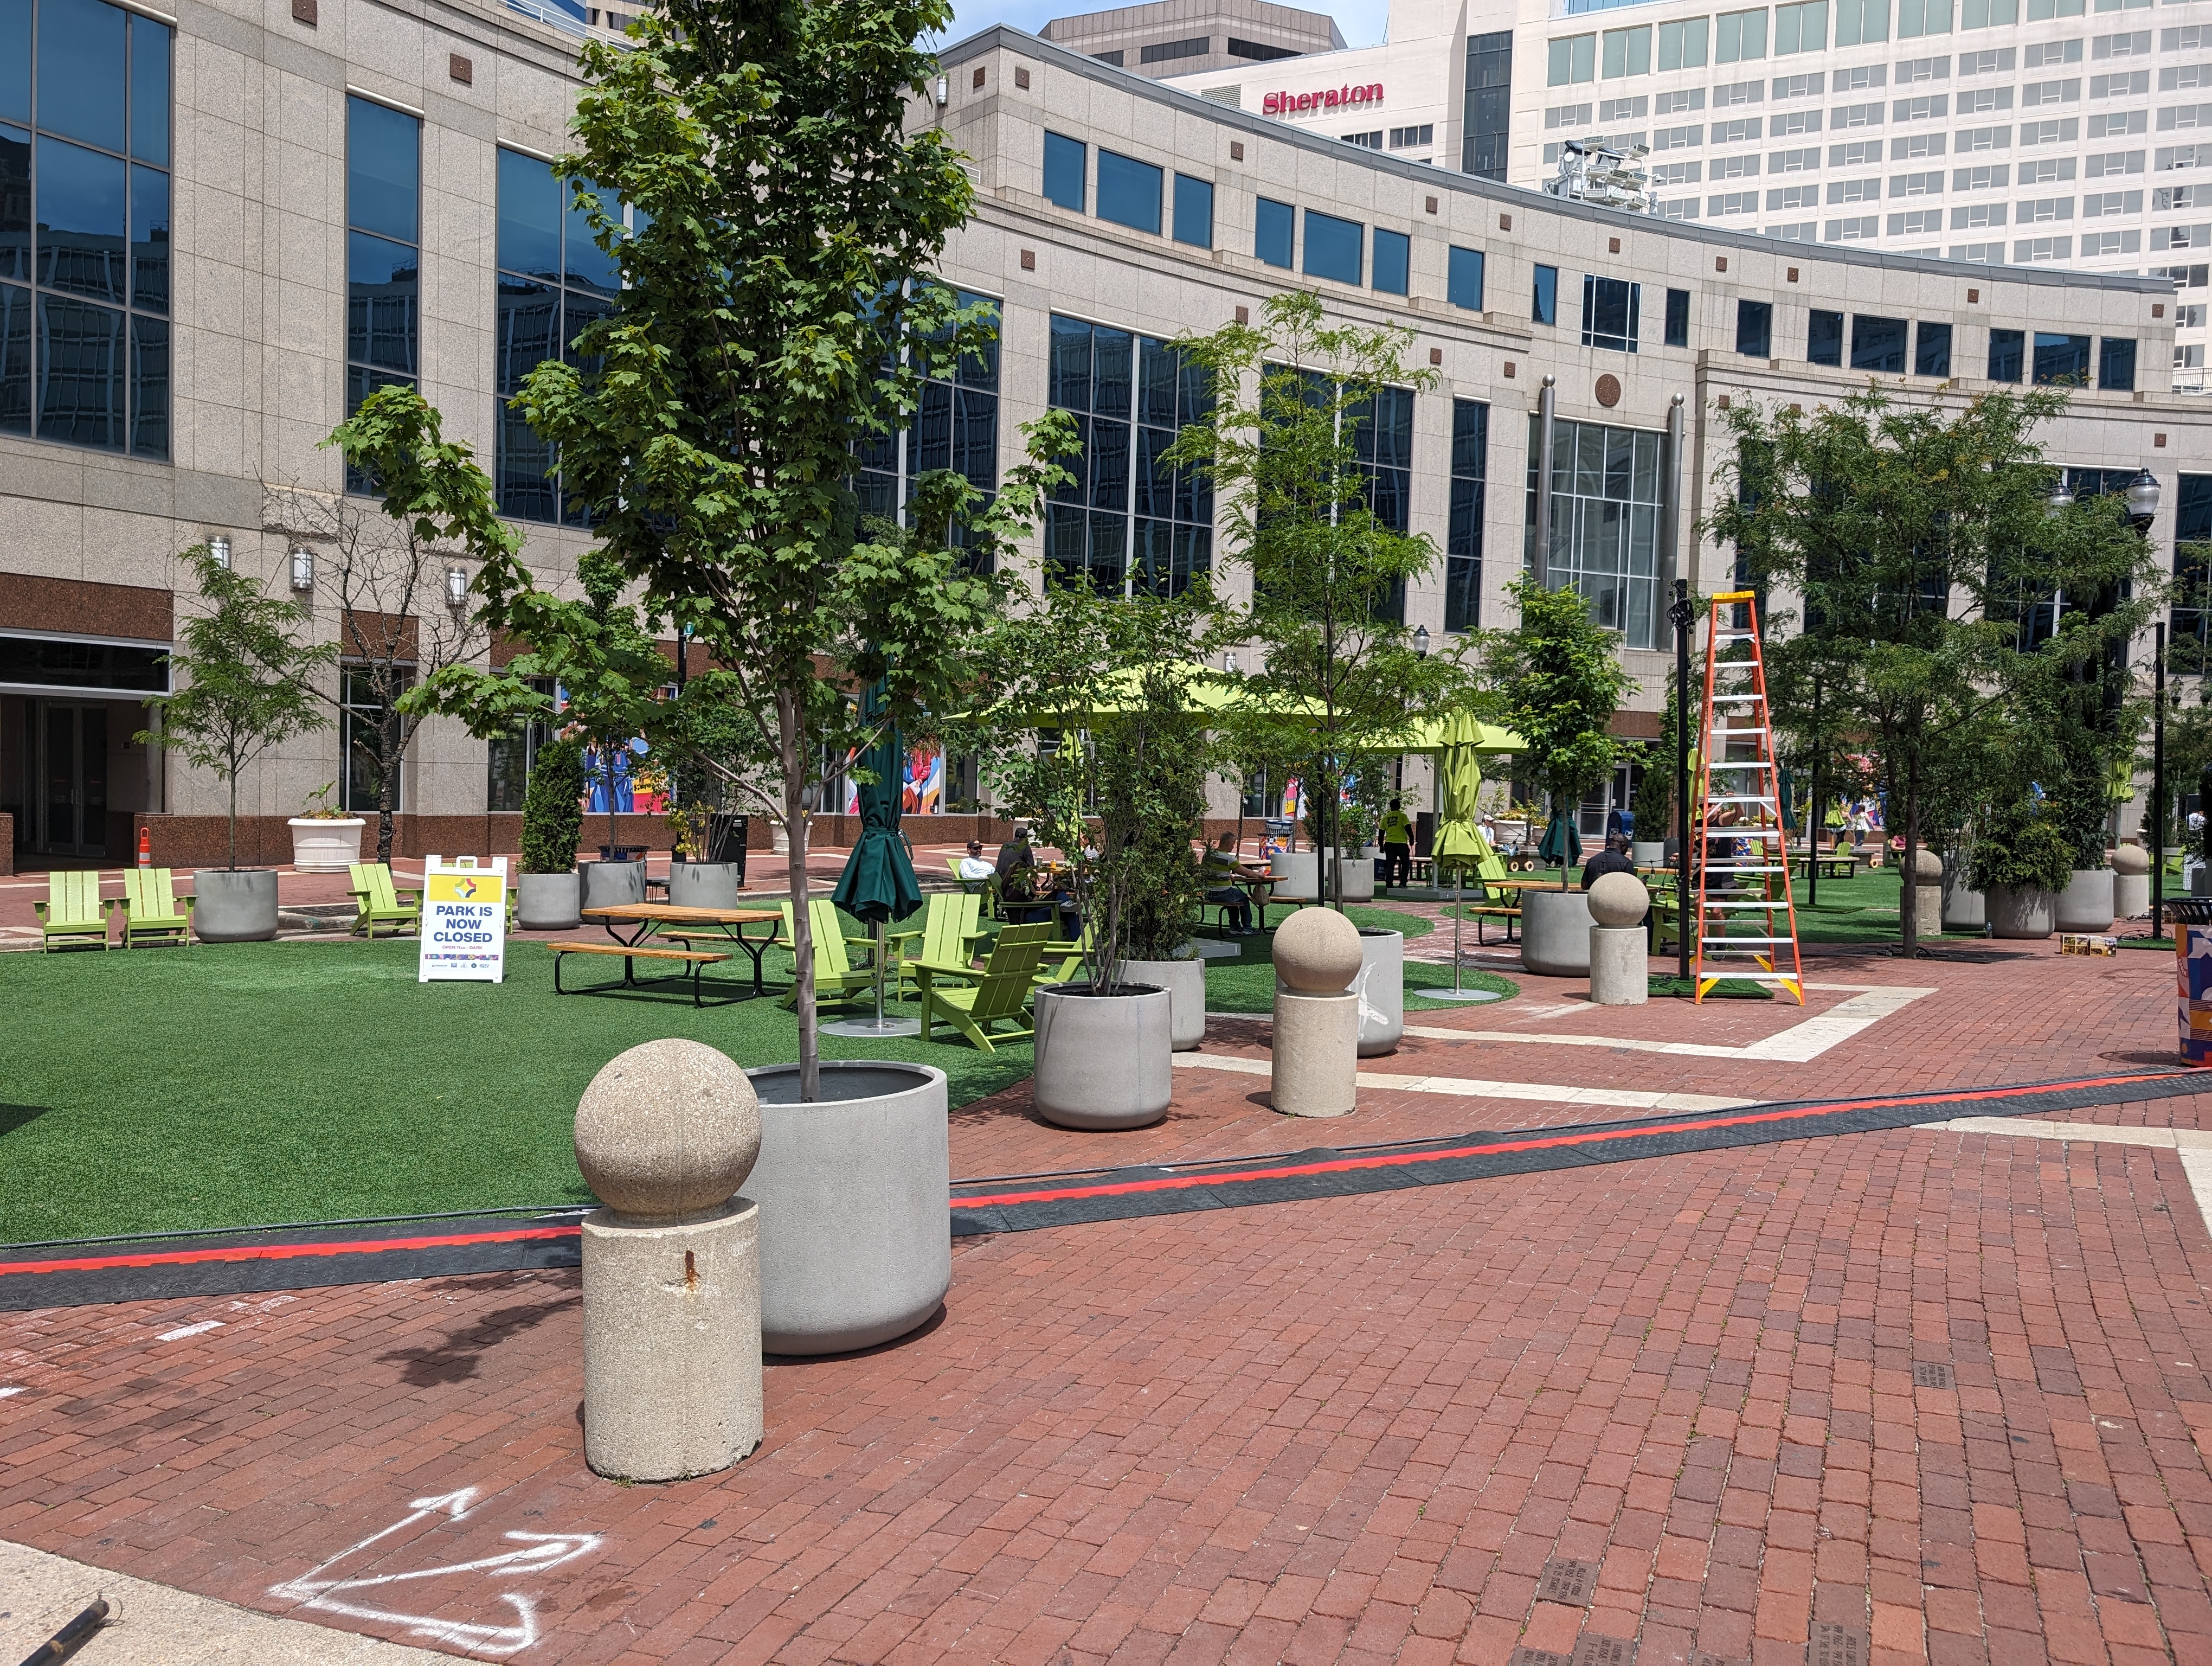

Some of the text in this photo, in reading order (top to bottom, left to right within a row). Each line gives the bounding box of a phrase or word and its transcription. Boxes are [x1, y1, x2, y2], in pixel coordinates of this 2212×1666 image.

[1262, 82, 1384, 116] Sheraton
[436, 905, 493, 917] PARK IS
[446, 919, 482, 930] NOW
[433, 932, 493, 943] CLOSED
[2178, 958, 2187, 976] SPARK
